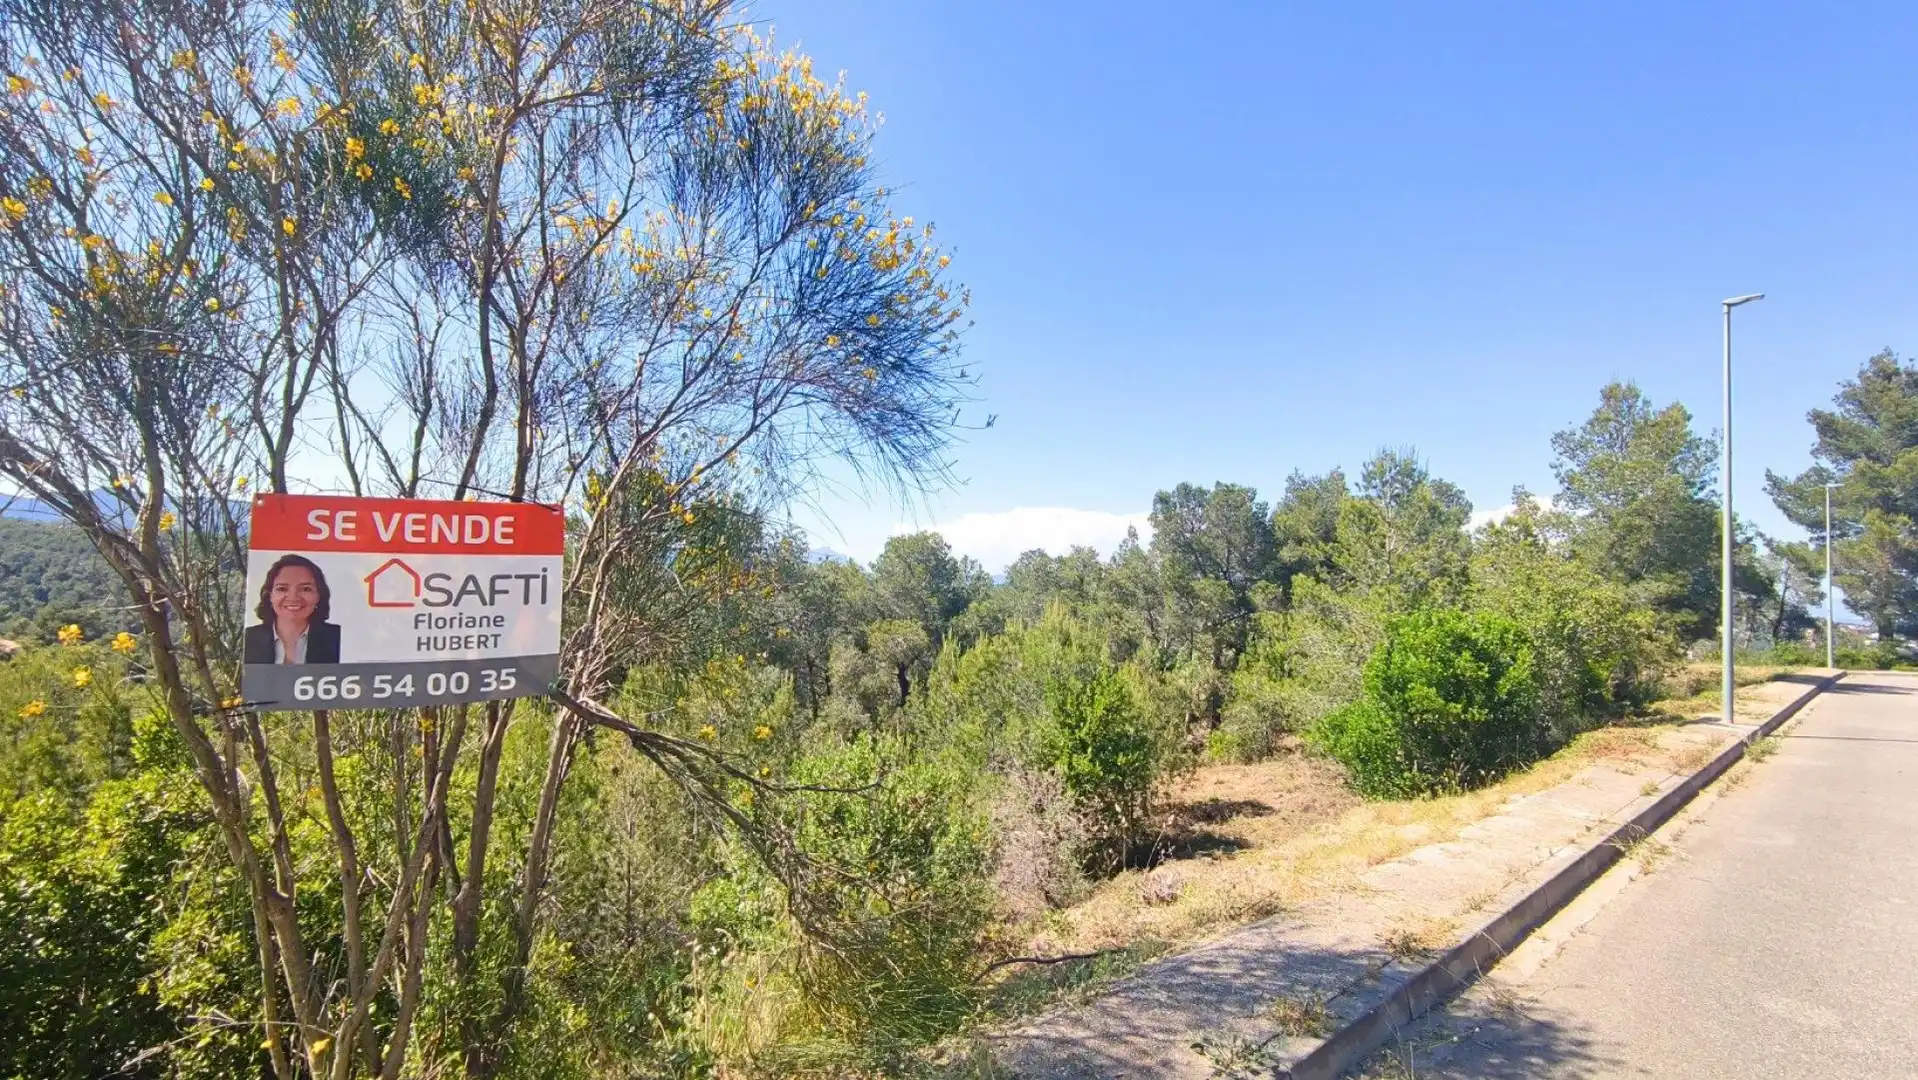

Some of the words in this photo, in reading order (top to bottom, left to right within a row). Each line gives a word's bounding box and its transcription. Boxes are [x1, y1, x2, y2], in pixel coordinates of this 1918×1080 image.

[307, 509, 357, 541] SE
[372, 512, 515, 545] VENDE
[413, 612, 505, 630] Floriane
[416, 634, 502, 652] HUBERT
[294, 675, 361, 701] 666
[372, 674, 415, 699] 54
[426, 671, 470, 695] 00
[479, 668, 517, 693] 35
